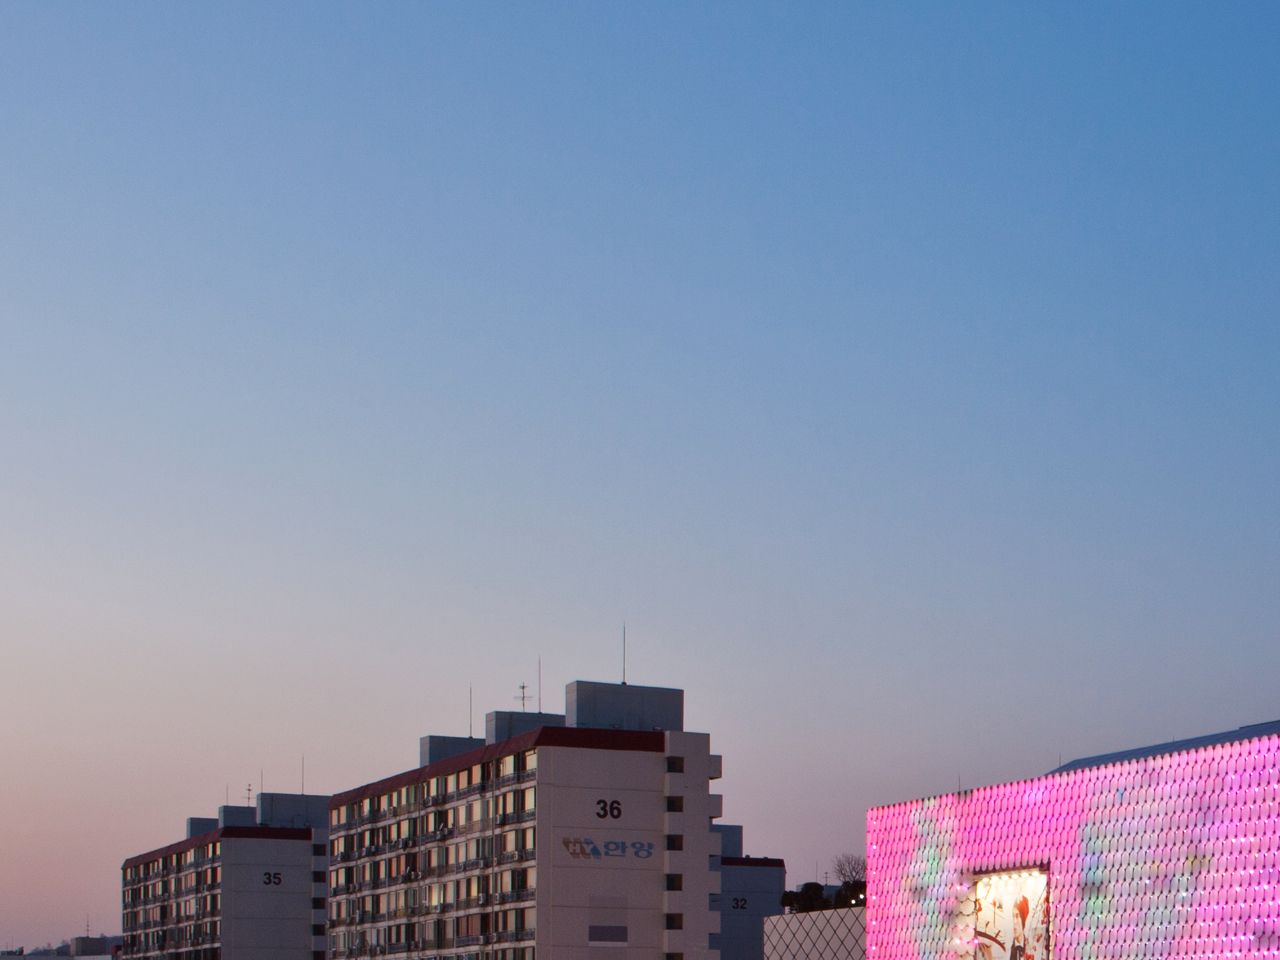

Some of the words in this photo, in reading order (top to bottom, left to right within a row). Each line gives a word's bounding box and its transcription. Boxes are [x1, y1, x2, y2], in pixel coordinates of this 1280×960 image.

[596, 799, 622, 819] 36
[604, 841, 656, 859] 한양
[263, 872, 282, 886] 35
[732, 898, 748, 910] 32
